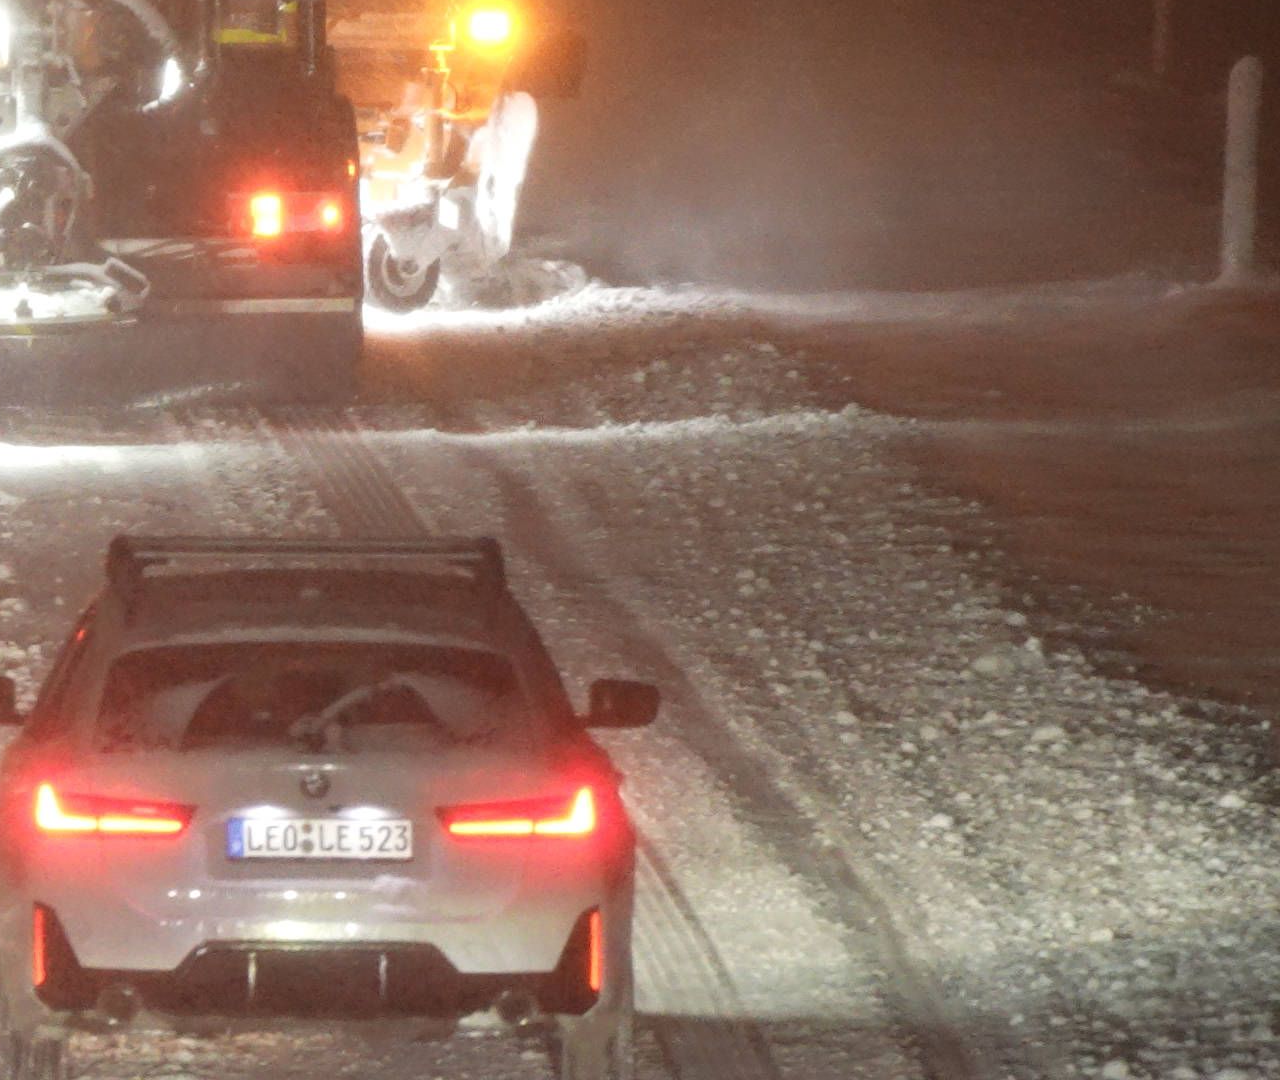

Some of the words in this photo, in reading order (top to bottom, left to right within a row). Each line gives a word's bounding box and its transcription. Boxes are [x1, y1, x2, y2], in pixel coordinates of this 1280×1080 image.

[247, 825, 298, 852] LEO
[319, 825, 352, 852] LE
[358, 825, 409, 852] 523
